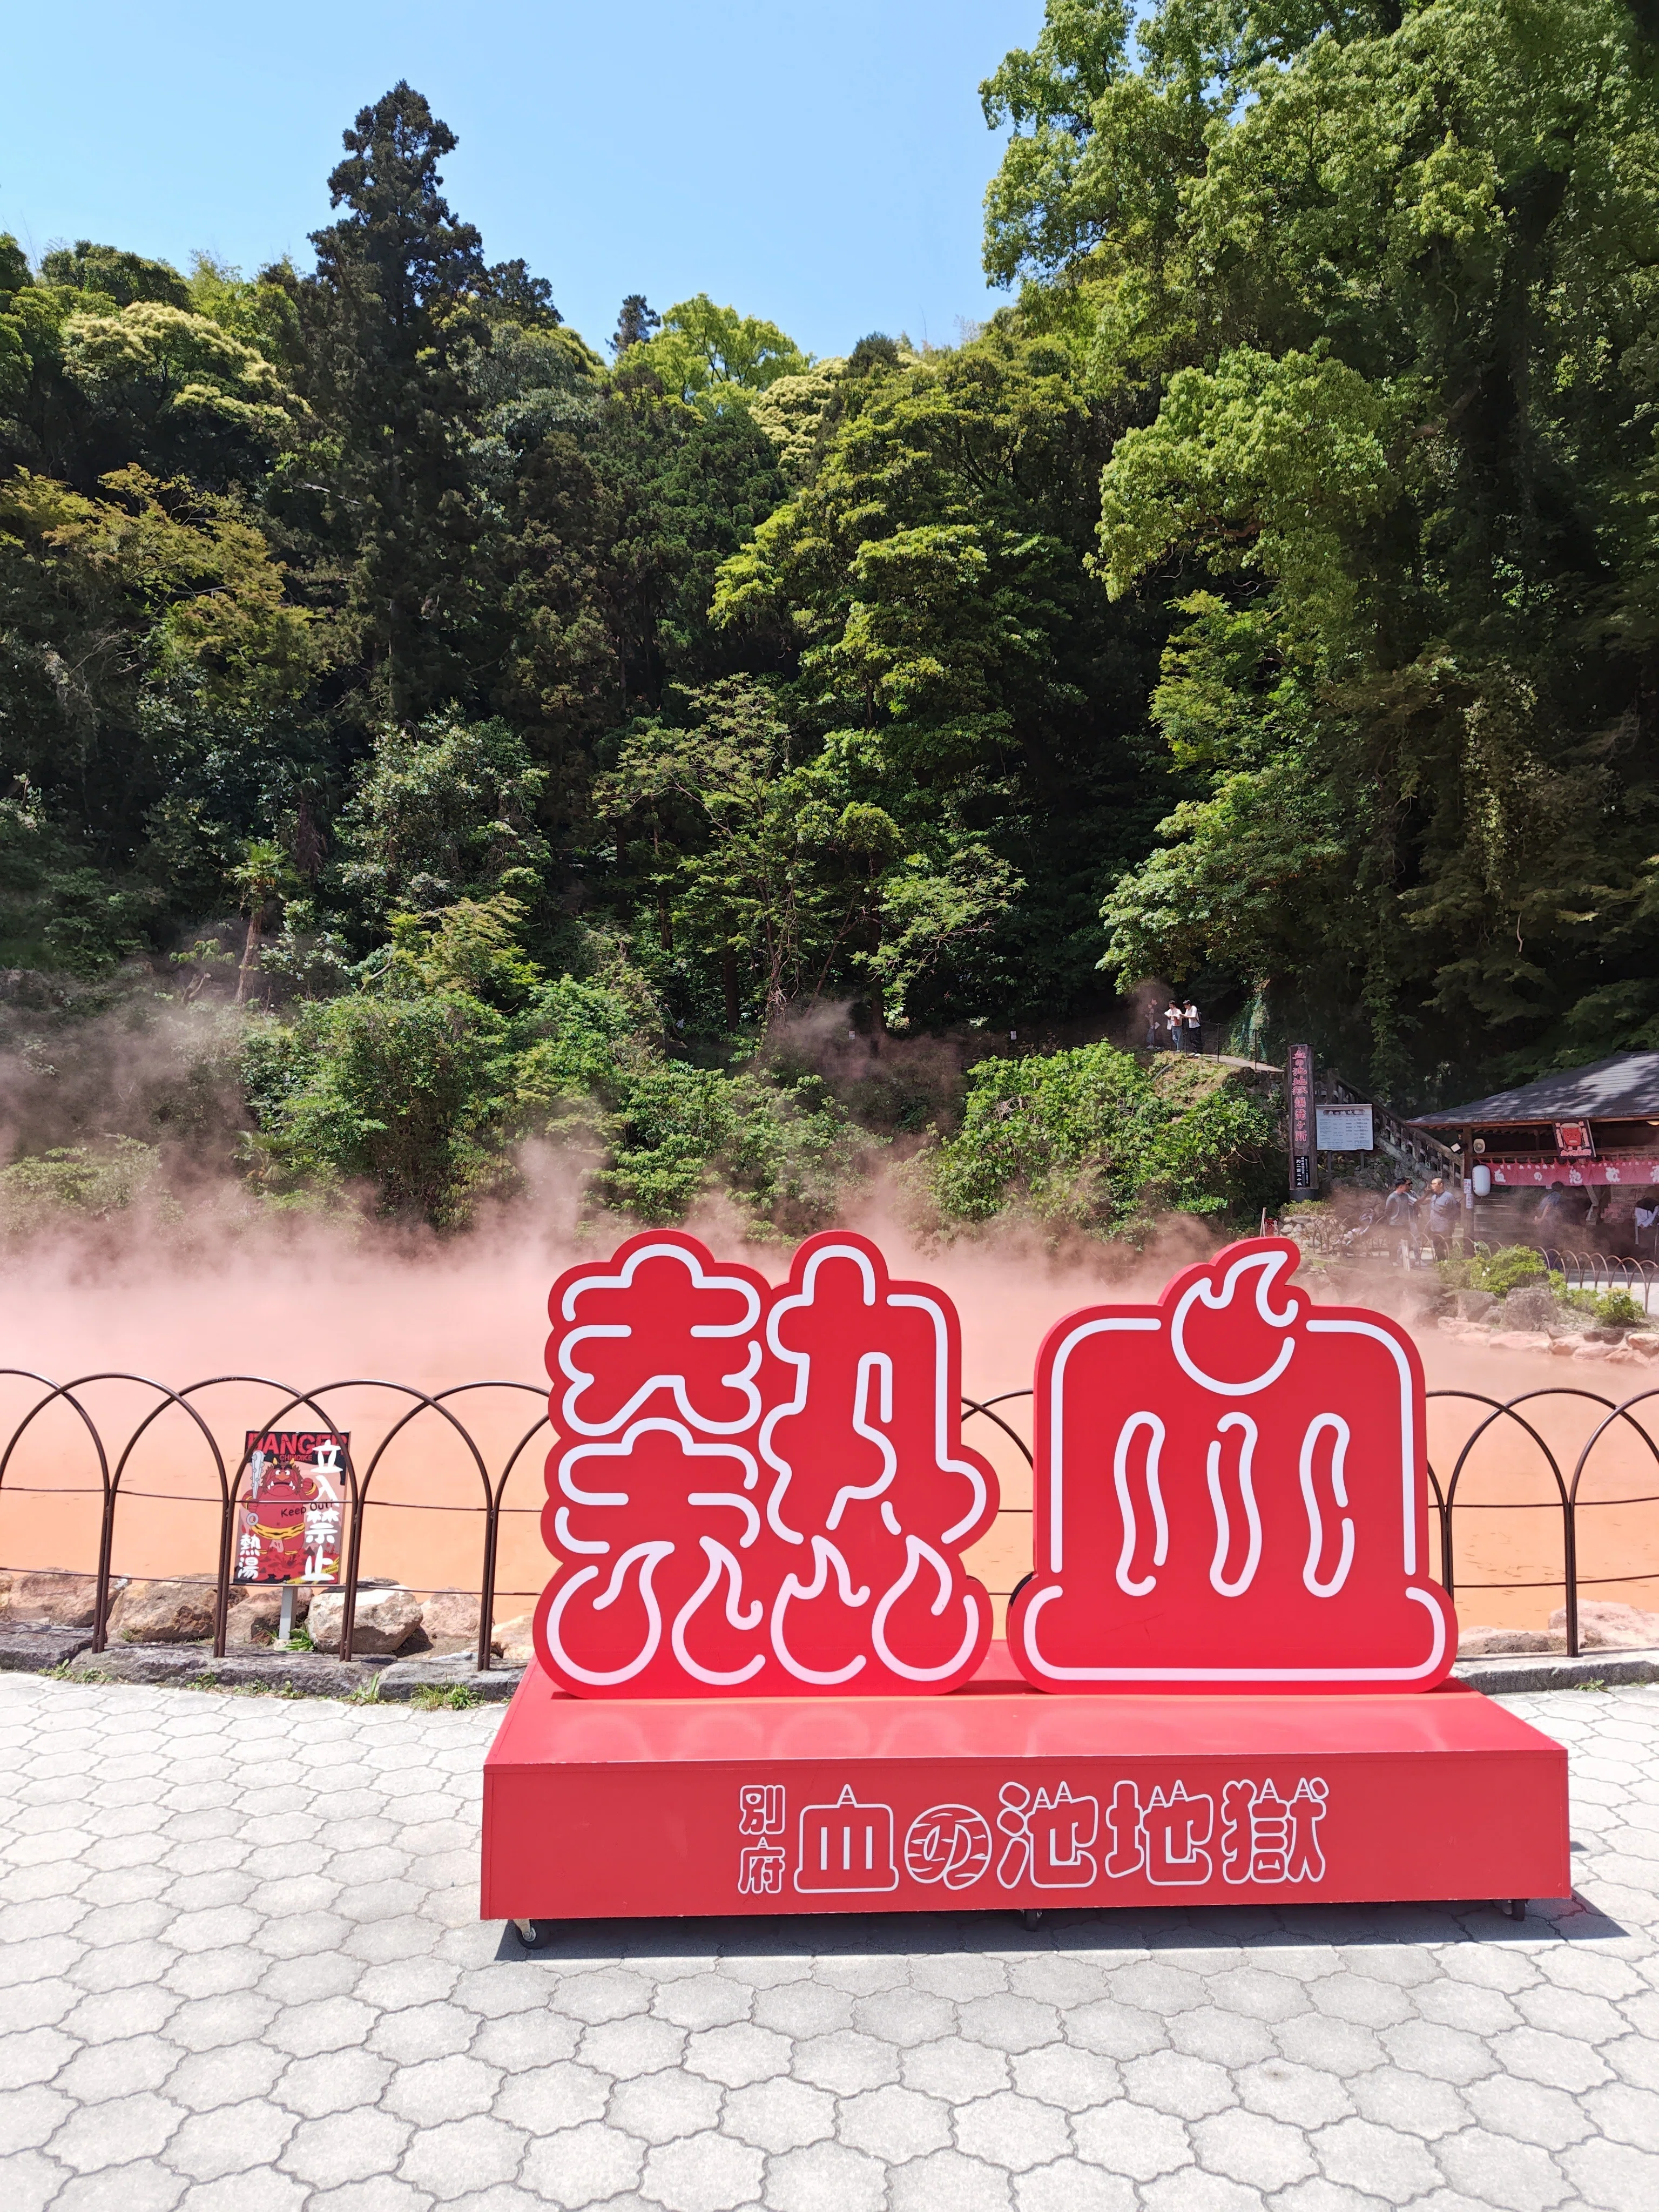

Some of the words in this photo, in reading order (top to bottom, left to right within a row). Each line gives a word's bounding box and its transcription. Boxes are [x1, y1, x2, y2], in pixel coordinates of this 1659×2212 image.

[238, 1533, 261, 1580] 熱湯
[281, 1507, 307, 1518] Keep
[300, 1439, 343, 1581] 立入禁止
[738, 1785, 785, 1894] 別府
[793, 1777, 1328, 1893] 血の池地獄
